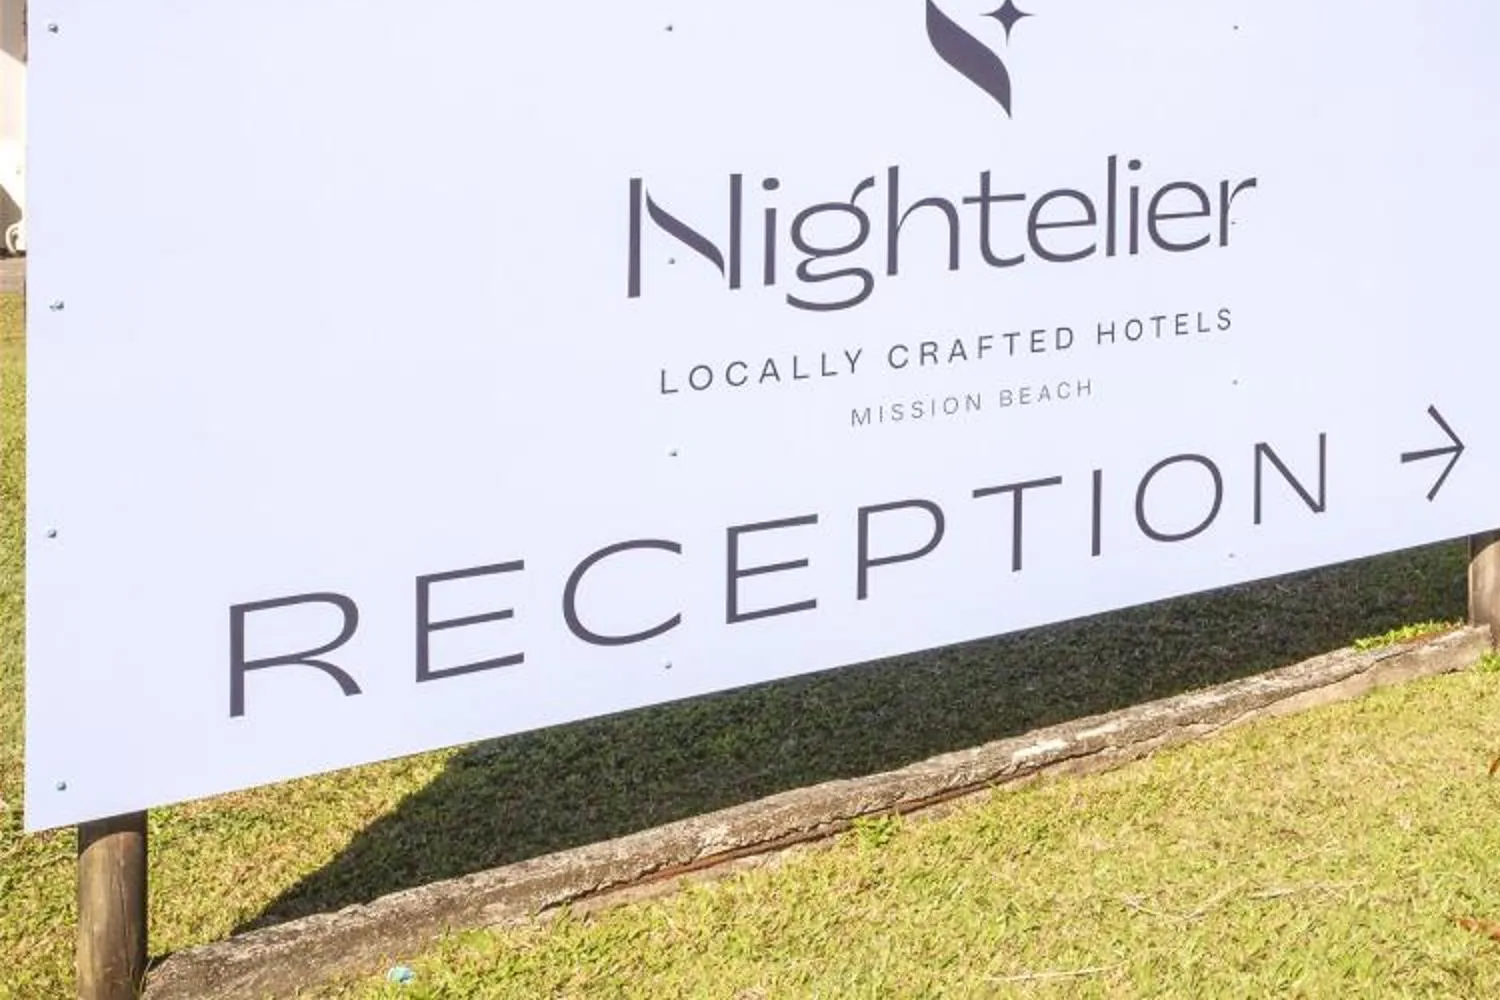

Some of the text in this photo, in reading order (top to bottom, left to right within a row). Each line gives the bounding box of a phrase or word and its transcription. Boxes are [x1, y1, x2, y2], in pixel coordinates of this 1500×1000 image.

[629, 155, 1257, 312] Nightelier
[660, 308, 1233, 395] LOCALLY CRAFTED HOTELS
[850, 379, 1093, 427] MISSION BEACH
[229, 433, 1326, 718] RECEPTION
